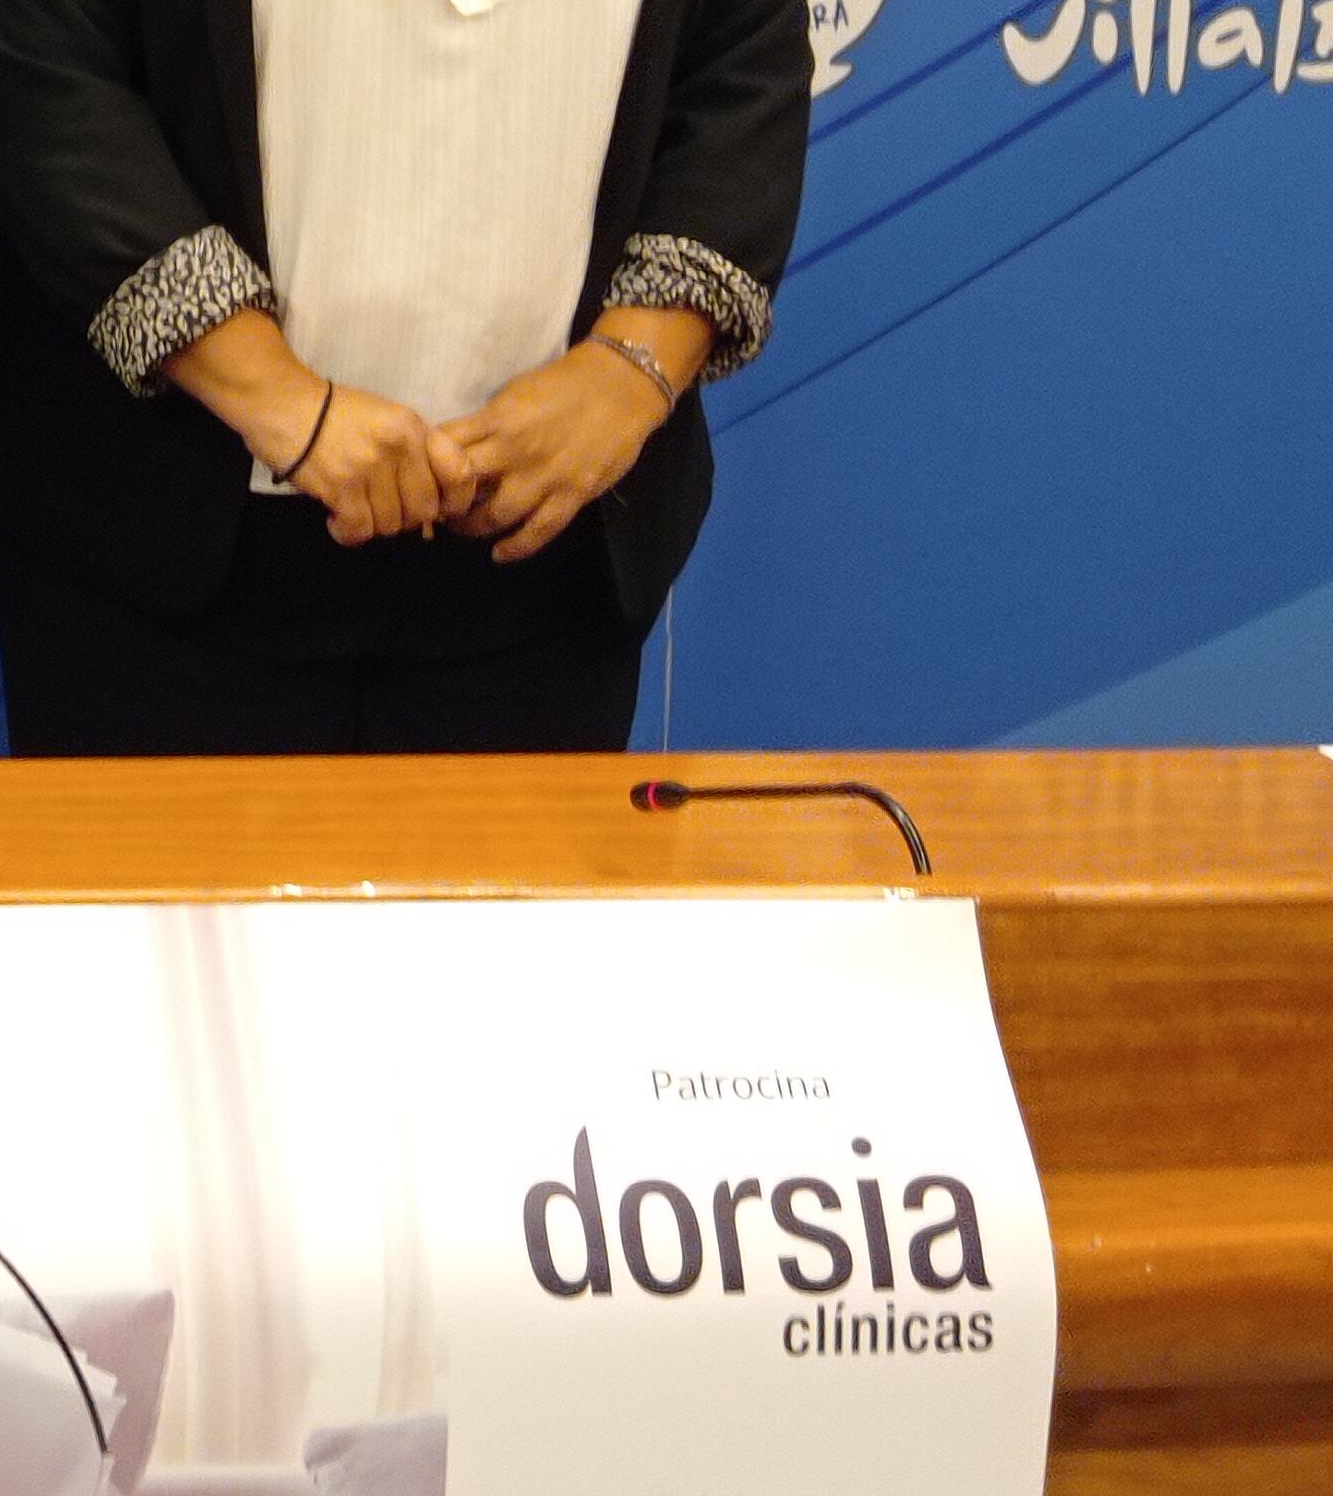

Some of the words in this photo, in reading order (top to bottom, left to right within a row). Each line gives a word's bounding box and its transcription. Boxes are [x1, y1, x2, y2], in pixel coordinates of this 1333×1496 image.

[650, 1068, 832, 1101] Patrocina
[522, 1124, 994, 1298] dorsia
[783, 1301, 995, 1357] clínicas
